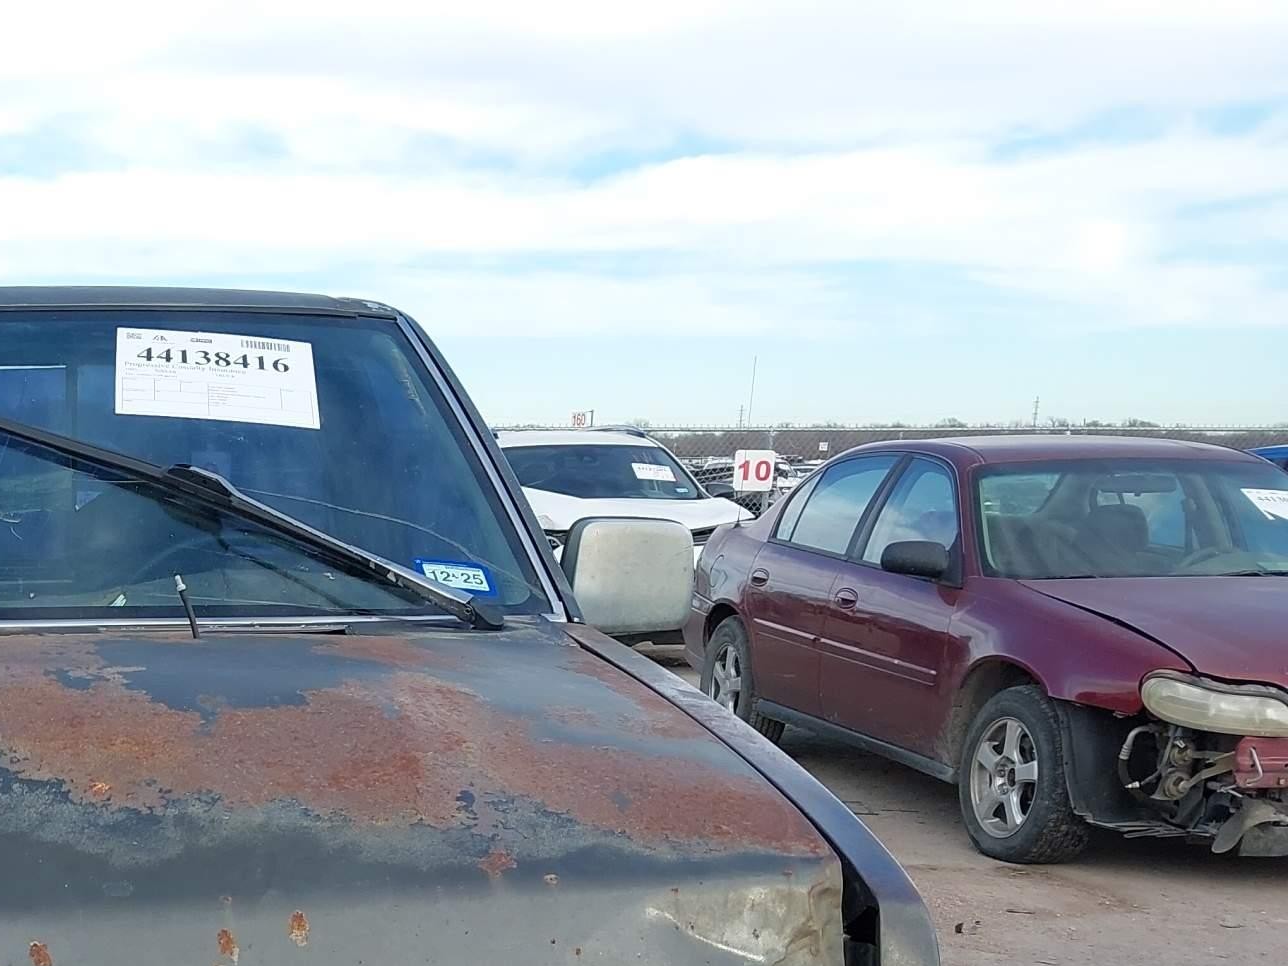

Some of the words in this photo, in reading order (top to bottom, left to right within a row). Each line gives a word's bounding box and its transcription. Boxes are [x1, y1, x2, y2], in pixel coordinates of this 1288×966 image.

[137, 347, 289, 373] 44138416
[573, 411, 586, 426] 160
[738, 460, 771, 482] 10
[460, 572, 484, 585] 25
